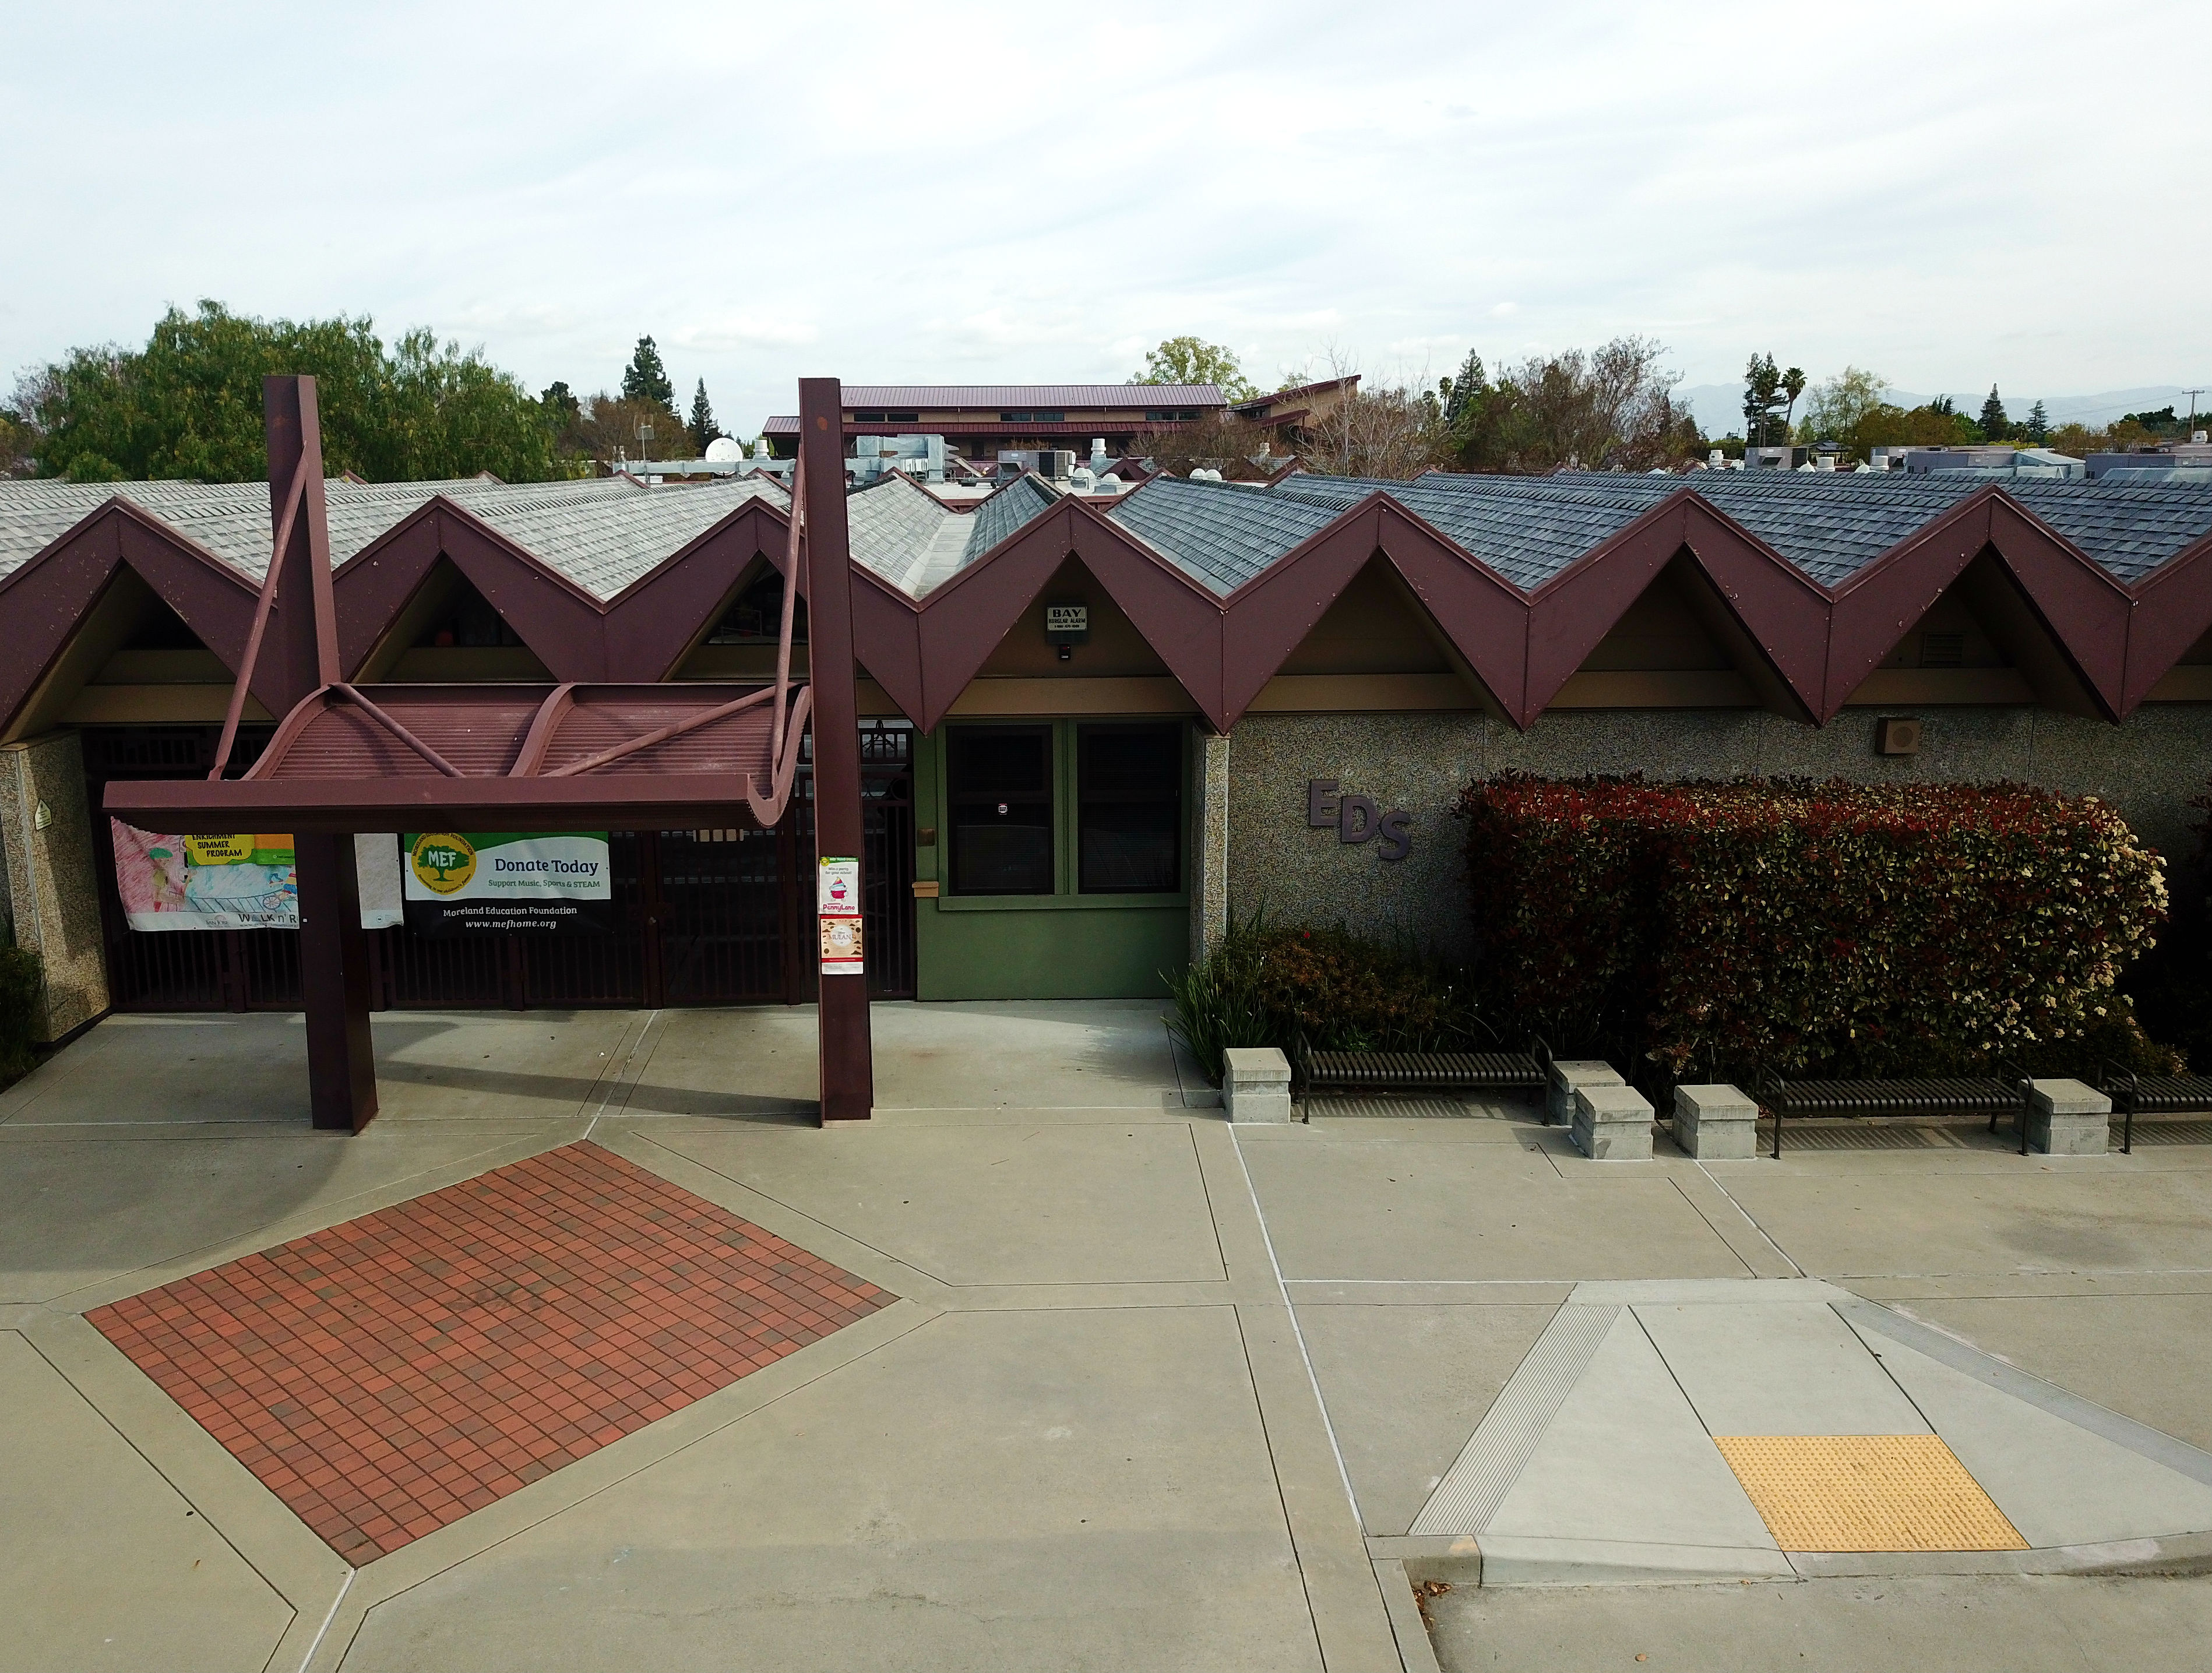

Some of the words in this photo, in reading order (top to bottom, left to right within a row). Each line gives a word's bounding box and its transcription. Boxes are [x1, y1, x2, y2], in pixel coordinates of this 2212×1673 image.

[1052, 609, 1082, 618] BAY
[1309, 779, 1411, 860] EDS
[198, 841, 230, 849] SUMMER
[206, 848, 242, 858] PROGRAM
[428, 850, 457, 867] MEF
[495, 858, 549, 872] Donate
[551, 860, 599, 876] Today
[488, 879, 516, 888] Support
[543, 879, 565, 887] Sports
[443, 907, 484, 917] Moreland
[485, 907, 527, 915] Education
[529, 906, 577, 915] Foundation
[466, 920, 556, 929] www.mefhome.org
